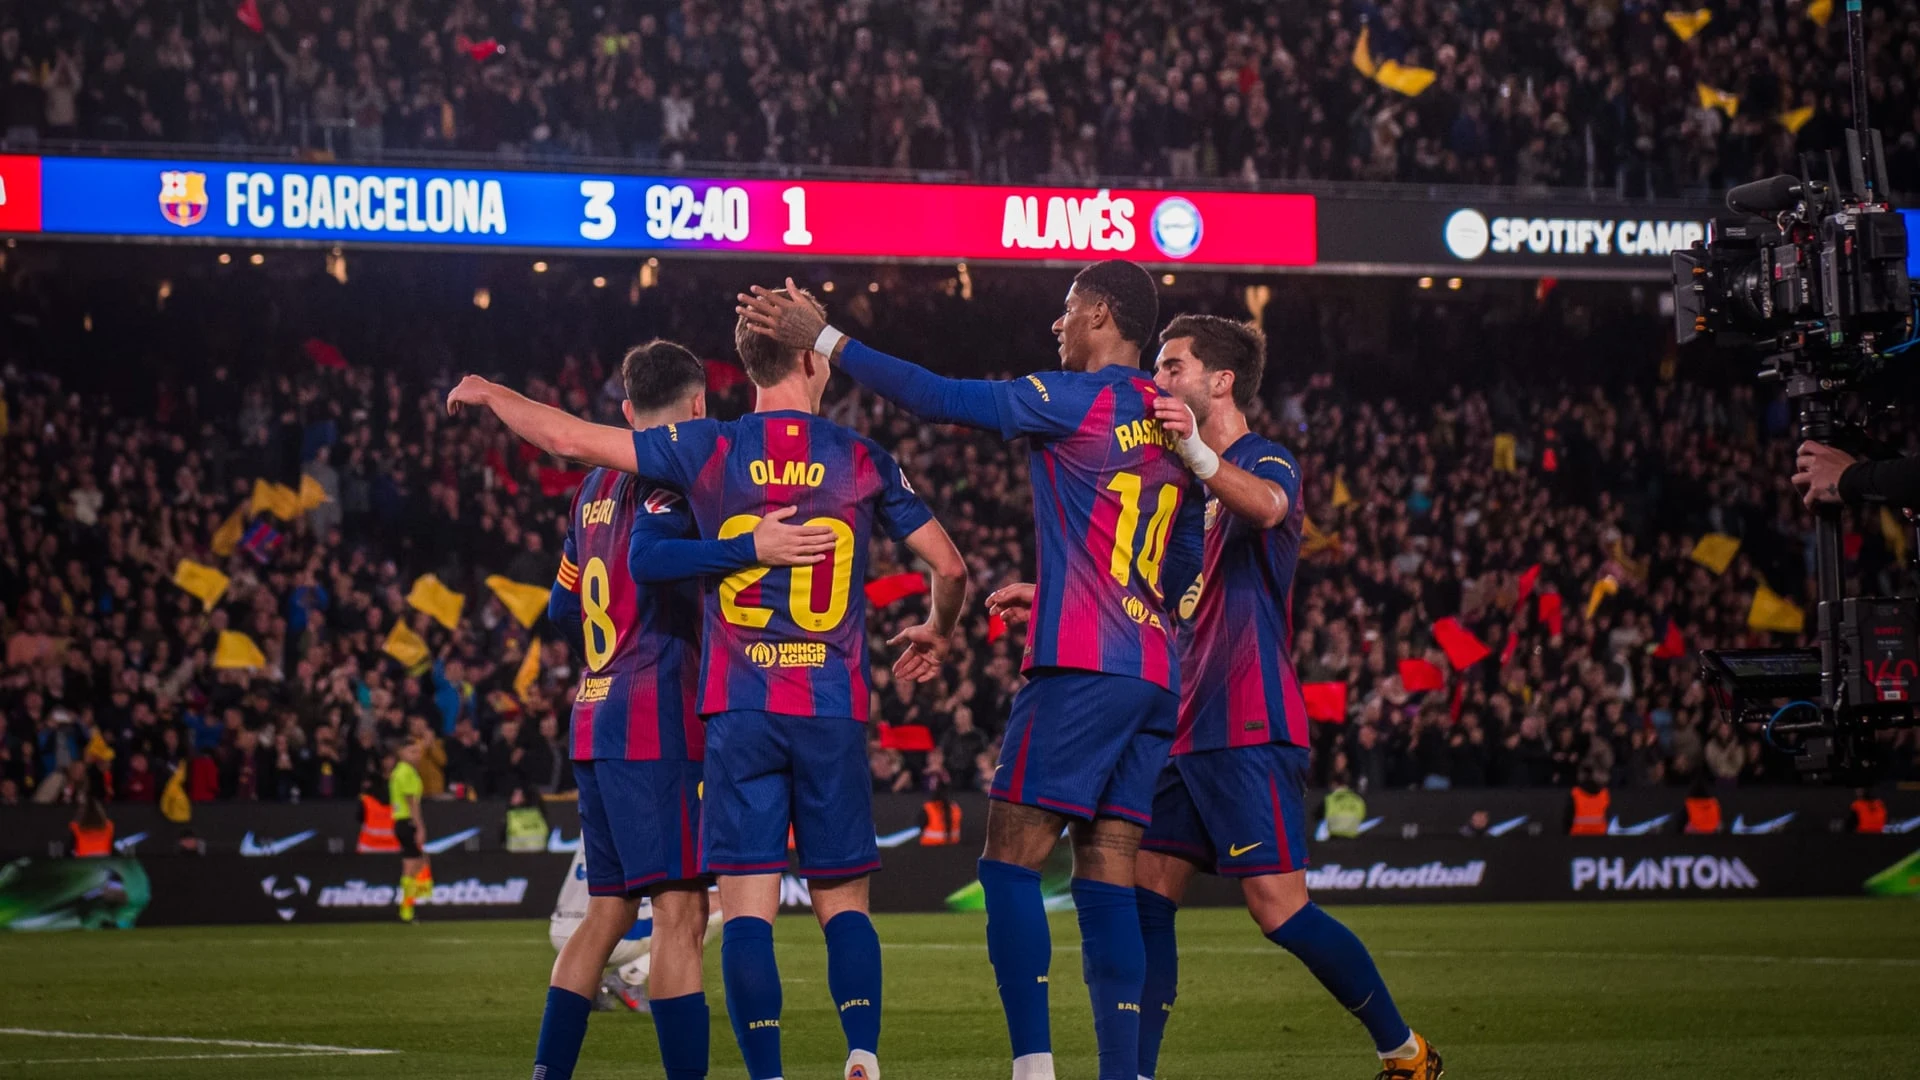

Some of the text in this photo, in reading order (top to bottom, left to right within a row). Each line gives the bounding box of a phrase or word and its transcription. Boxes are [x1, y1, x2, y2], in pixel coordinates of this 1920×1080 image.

[226, 171, 507, 235] FC BARCELONA
[580, 180, 617, 240] 3
[646, 184, 750, 242] 92:40
[782, 186, 813, 246] 1
[1002, 188, 1136, 252] ALAVÉS
[1491, 216, 1615, 255] SPOTIFY
[1616, 219, 1704, 256] CAMP
[749, 460, 825, 488] OLMO
[1107, 472, 1179, 600] 14
[718, 514, 855, 632] 20
[582, 557, 617, 673] 8
[778, 643, 826, 654] UNHCR
[779, 653, 826, 664] ACNUR
[318, 878, 528, 907] nike otball
[1306, 860, 1486, 890] nike football
[1572, 855, 1759, 890] PHANTOM
